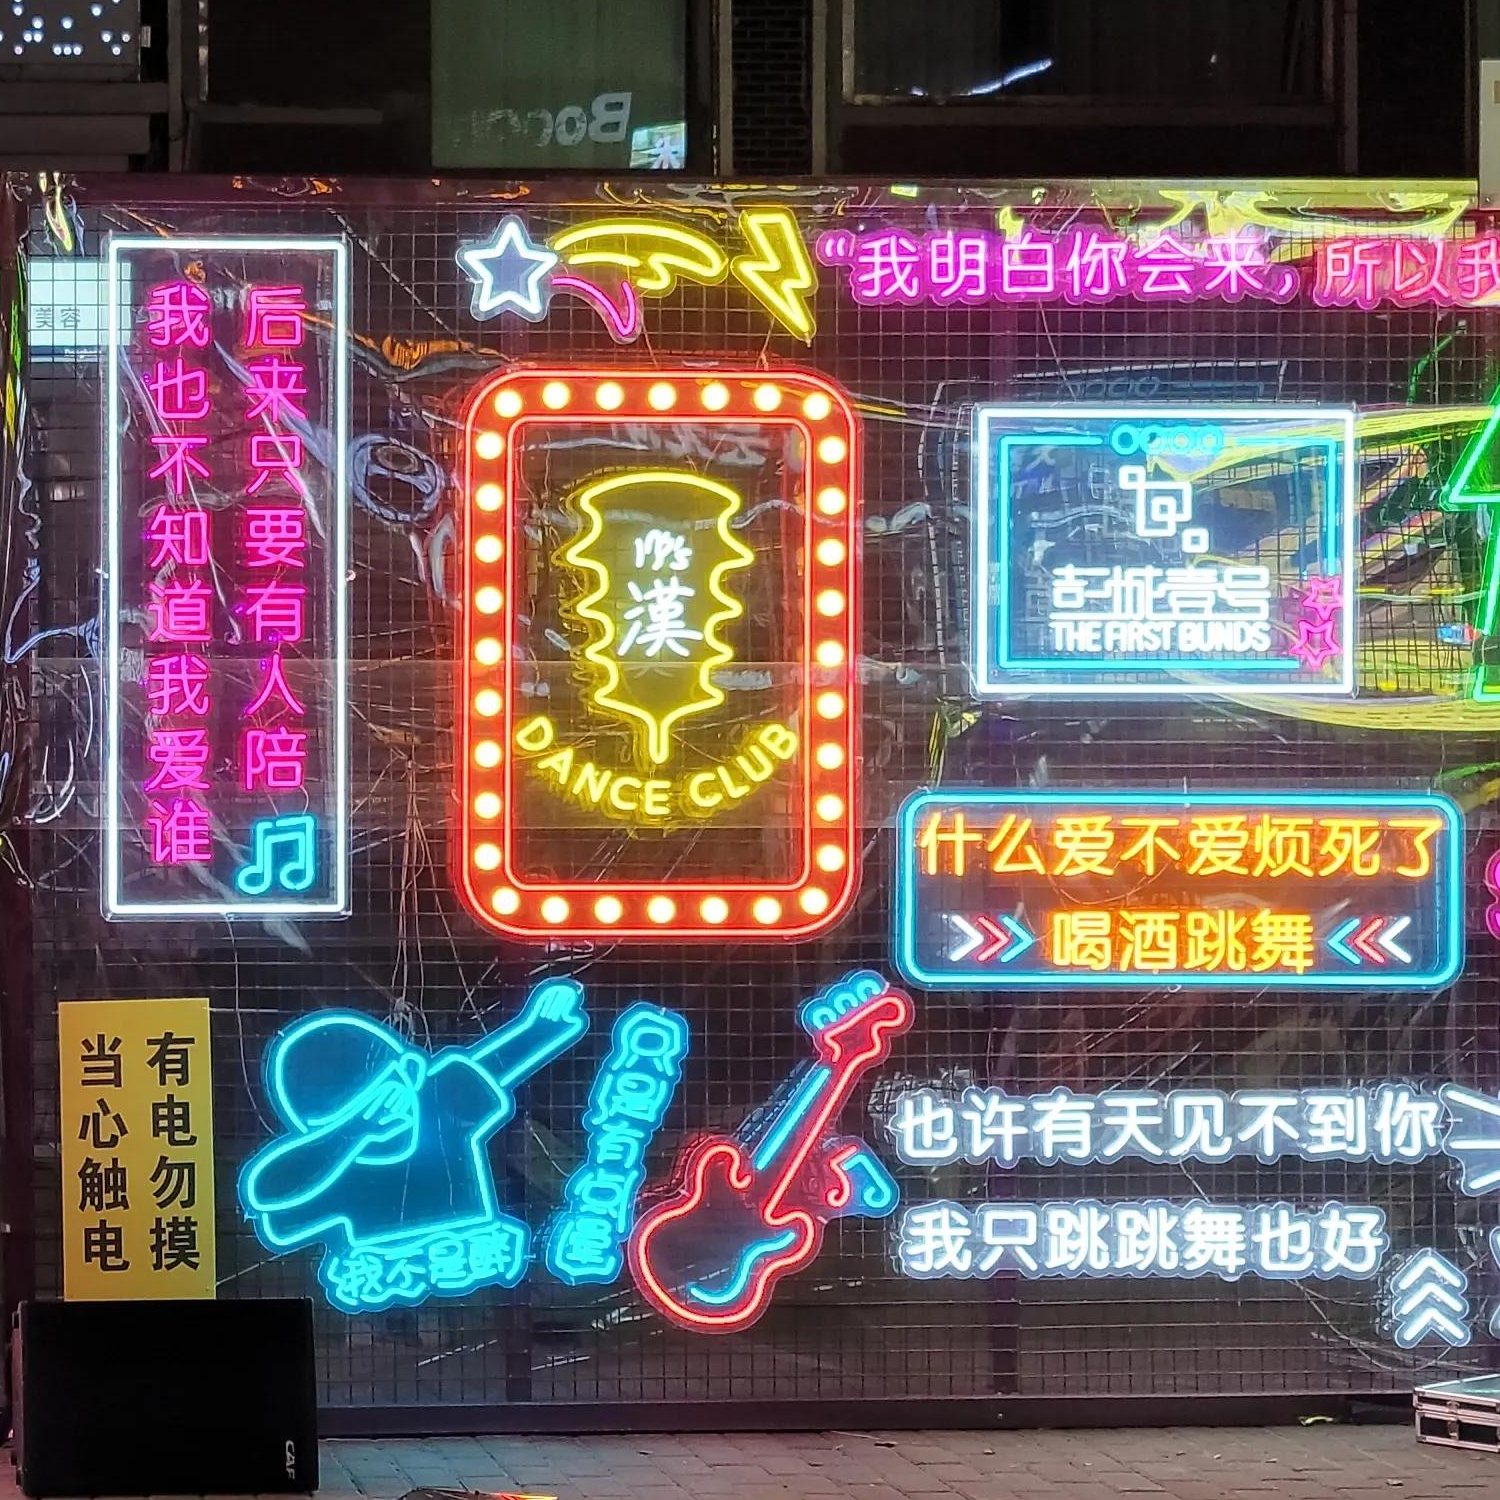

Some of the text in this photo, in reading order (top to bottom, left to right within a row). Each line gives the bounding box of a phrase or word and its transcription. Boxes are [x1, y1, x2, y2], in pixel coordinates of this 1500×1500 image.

[146, 282, 213, 867] 我也不知道我爱谁
[244, 284, 309, 794] 后来只要有人陪
[617, 576, 704, 658] 漢
[1049, 621, 1272, 653] THE FIRST BUNDS
[514, 713, 801, 817] DANCE CLUB
[918, 814, 1446, 879] 什么爱不爱烦死了
[1053, 908, 1317, 974] 喝酒跳舞
[76, 1032, 130, 1273] 当心触电
[146, 1030, 203, 1273] 有电勿摸
[896, 1092, 1442, 1162] 也许有天见不到你
[904, 1203, 1386, 1275] 我只跳跳舞也好
